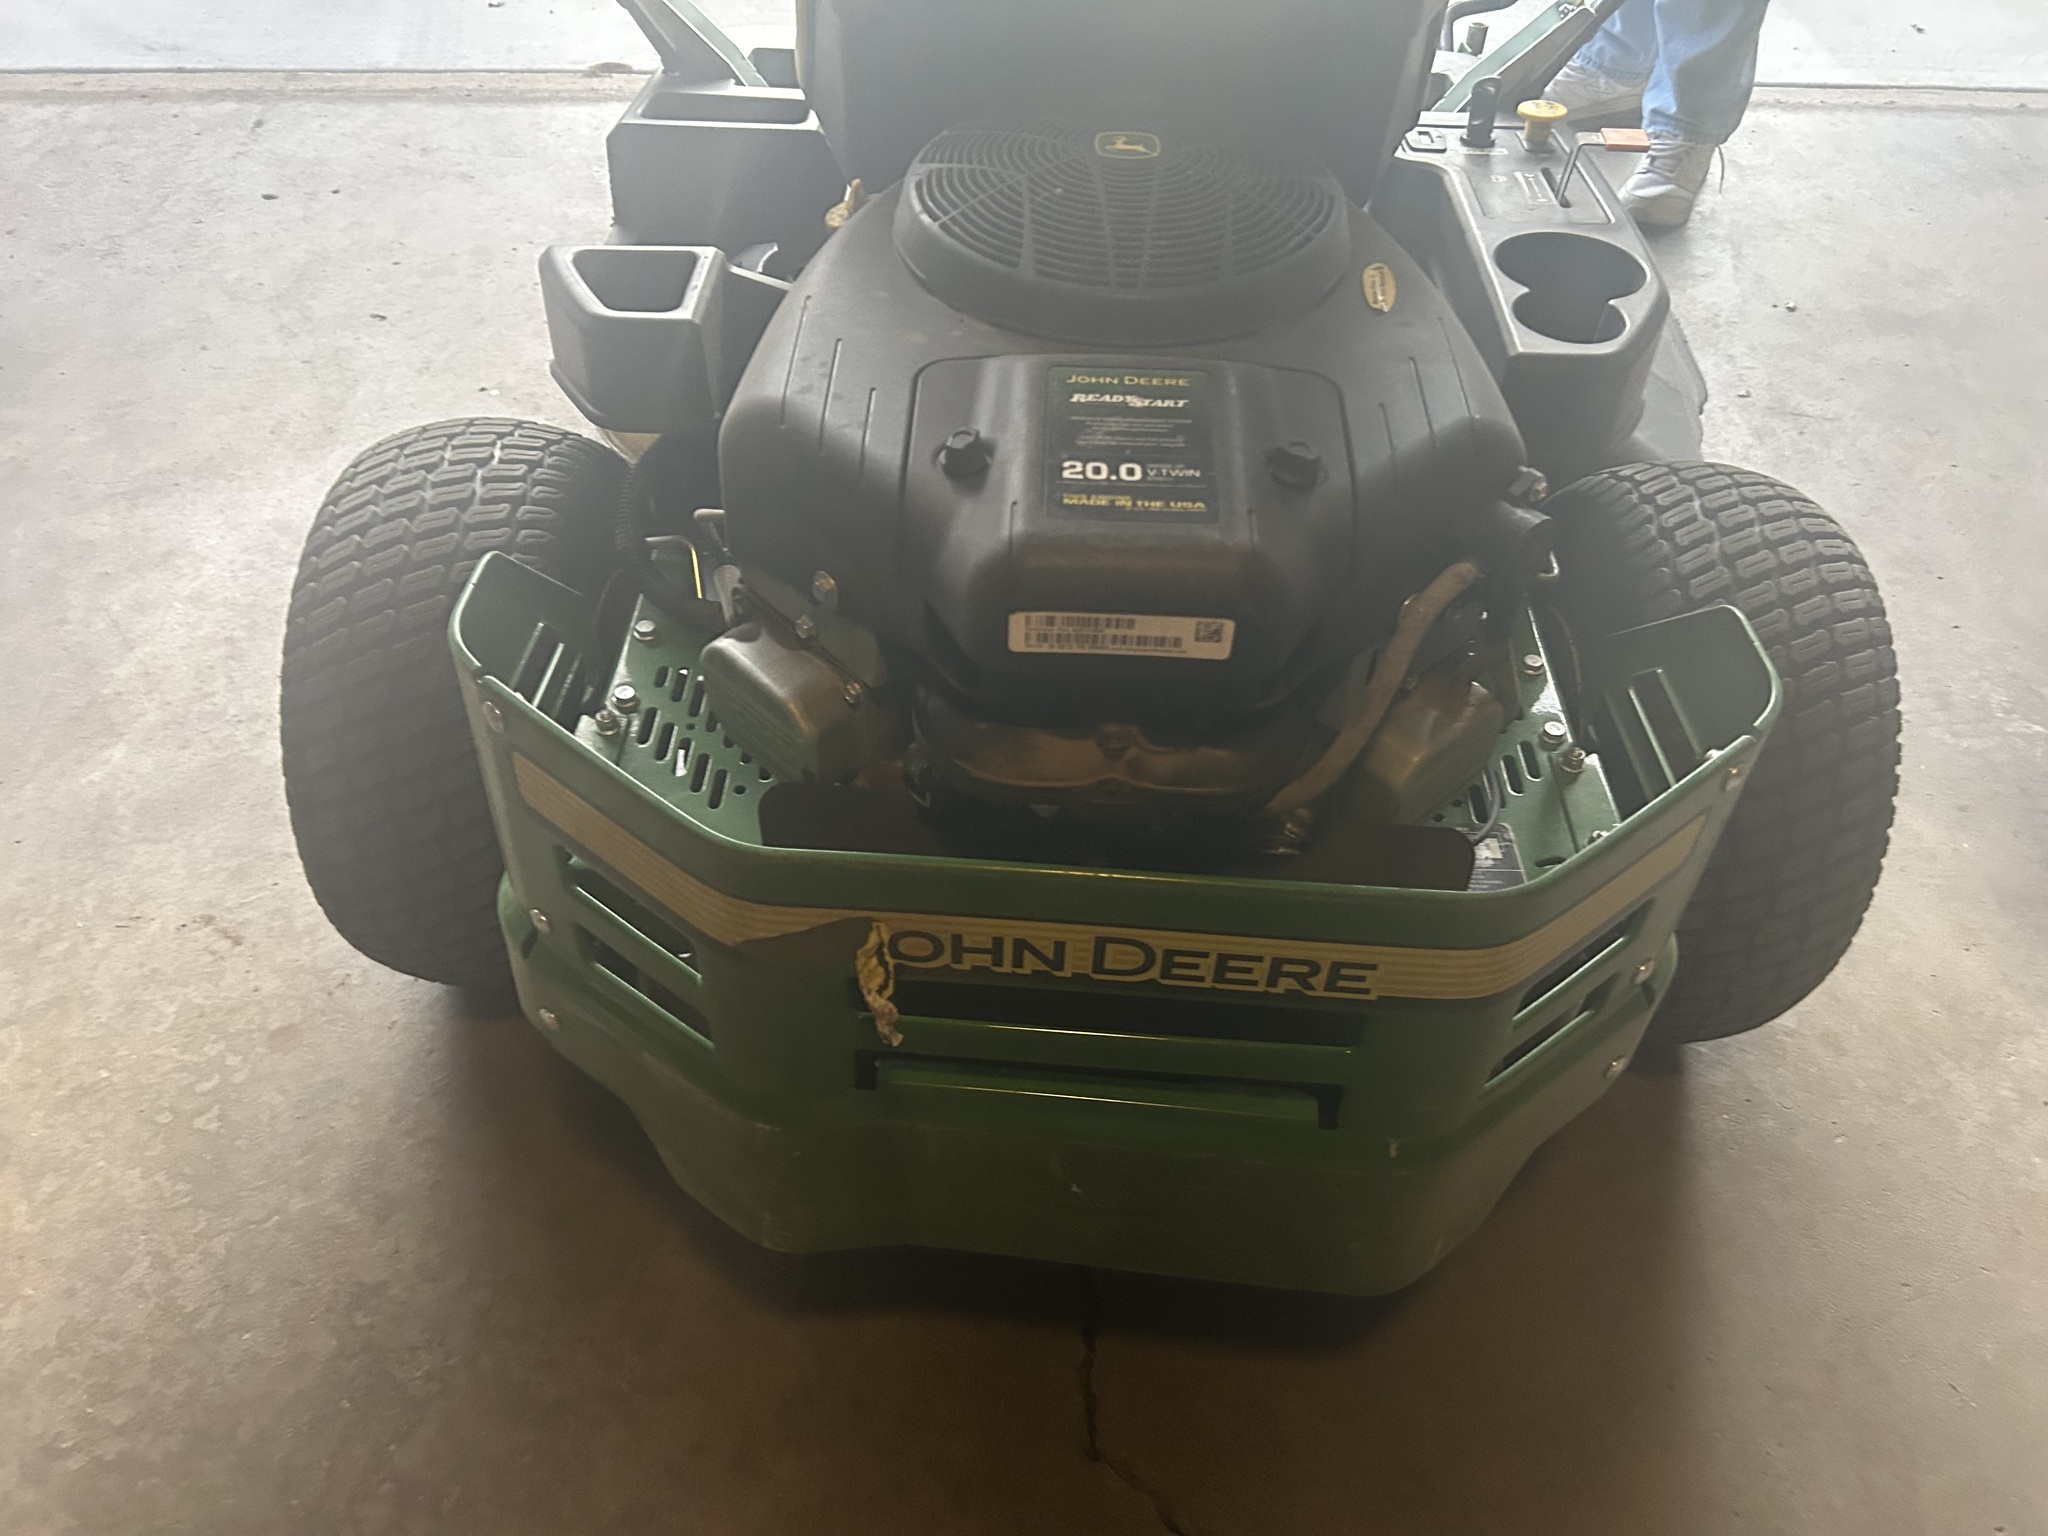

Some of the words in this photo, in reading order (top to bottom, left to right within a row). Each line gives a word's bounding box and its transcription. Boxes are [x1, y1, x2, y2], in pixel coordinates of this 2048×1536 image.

[1066, 375, 1118, 385] JOHN
[1123, 375, 1191, 386] DEERE
[1061, 460, 1142, 481] 20.0
[882, 930, 1067, 972] OHN
[1092, 936, 1378, 995] DEERE
